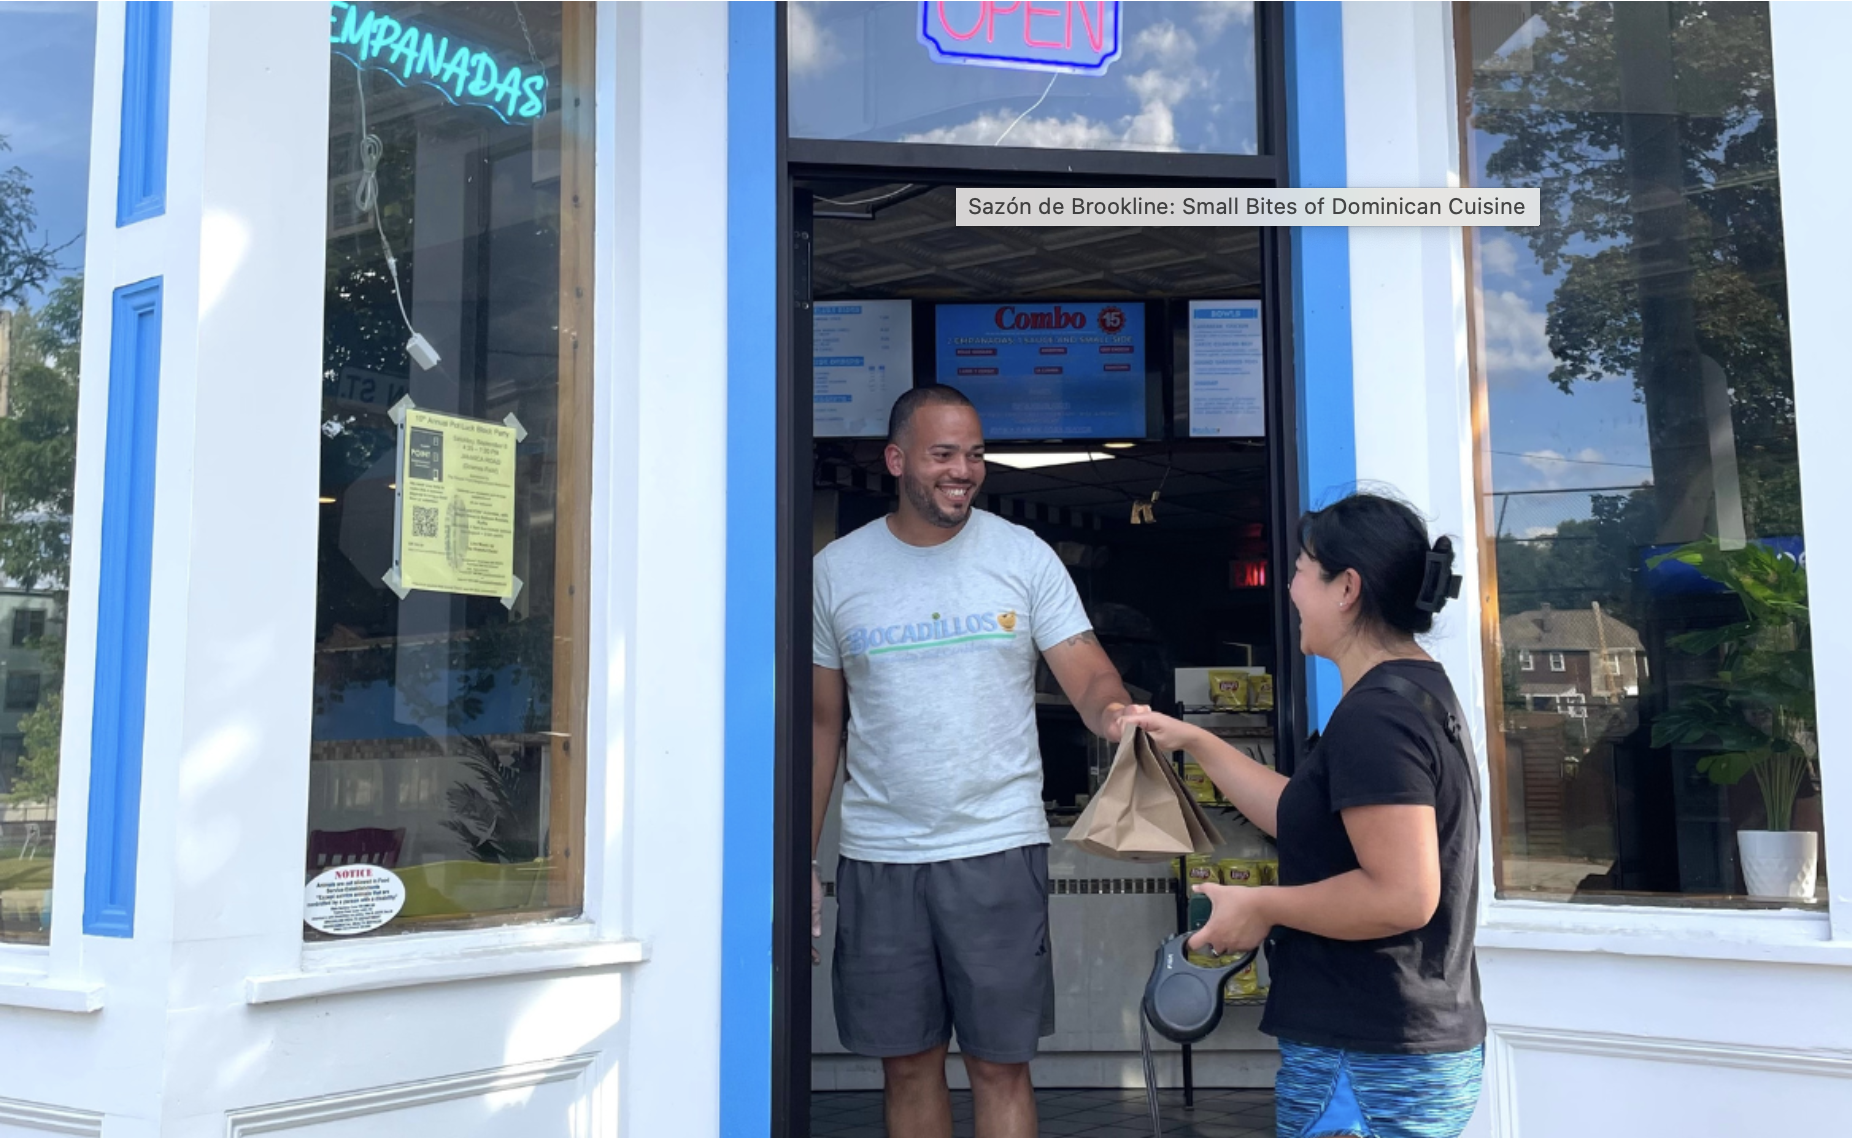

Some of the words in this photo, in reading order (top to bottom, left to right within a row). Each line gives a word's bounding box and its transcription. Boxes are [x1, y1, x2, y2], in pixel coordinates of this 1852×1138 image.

[937, 1, 1103, 53] OPEN
[330, 1, 544, 117] EMPANADAS
[994, 305, 1087, 331] Combo
[1102, 311, 1121, 327] 15
[335, 869, 373, 879] NOTICE
